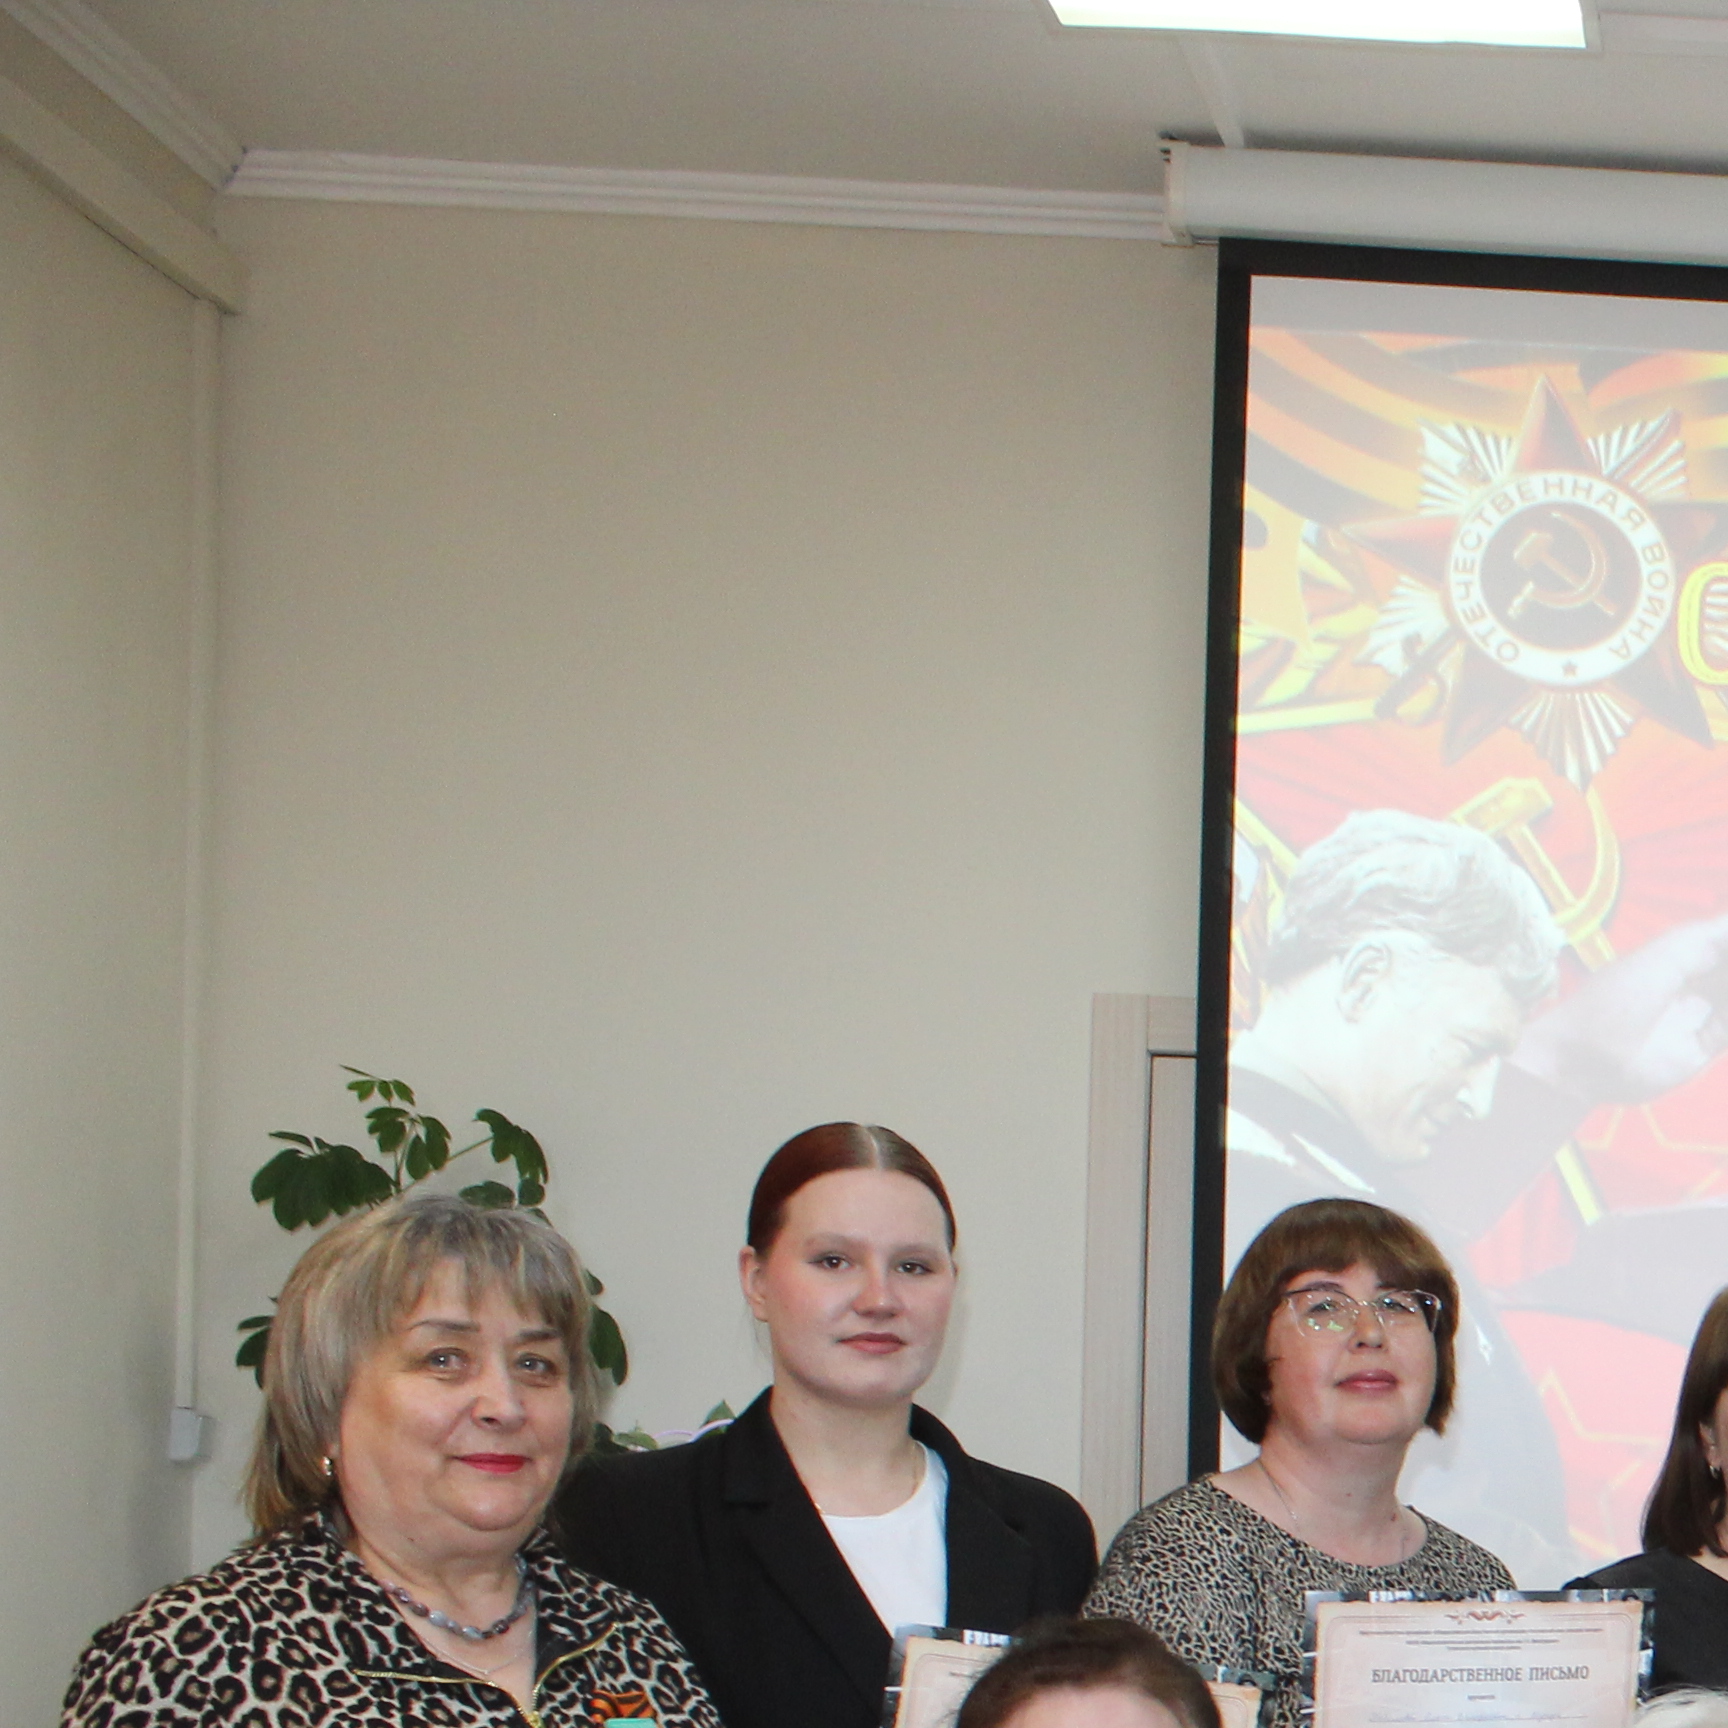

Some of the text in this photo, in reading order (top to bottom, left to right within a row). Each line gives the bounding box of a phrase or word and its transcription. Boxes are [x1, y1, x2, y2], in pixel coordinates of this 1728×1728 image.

[1455, 477, 1646, 662] ОТЕЧЕСТВЕННАЯ
[1371, 1665, 1589, 1683] БЛАГОДАРСТВЕННОЕ ПИСЬМО
